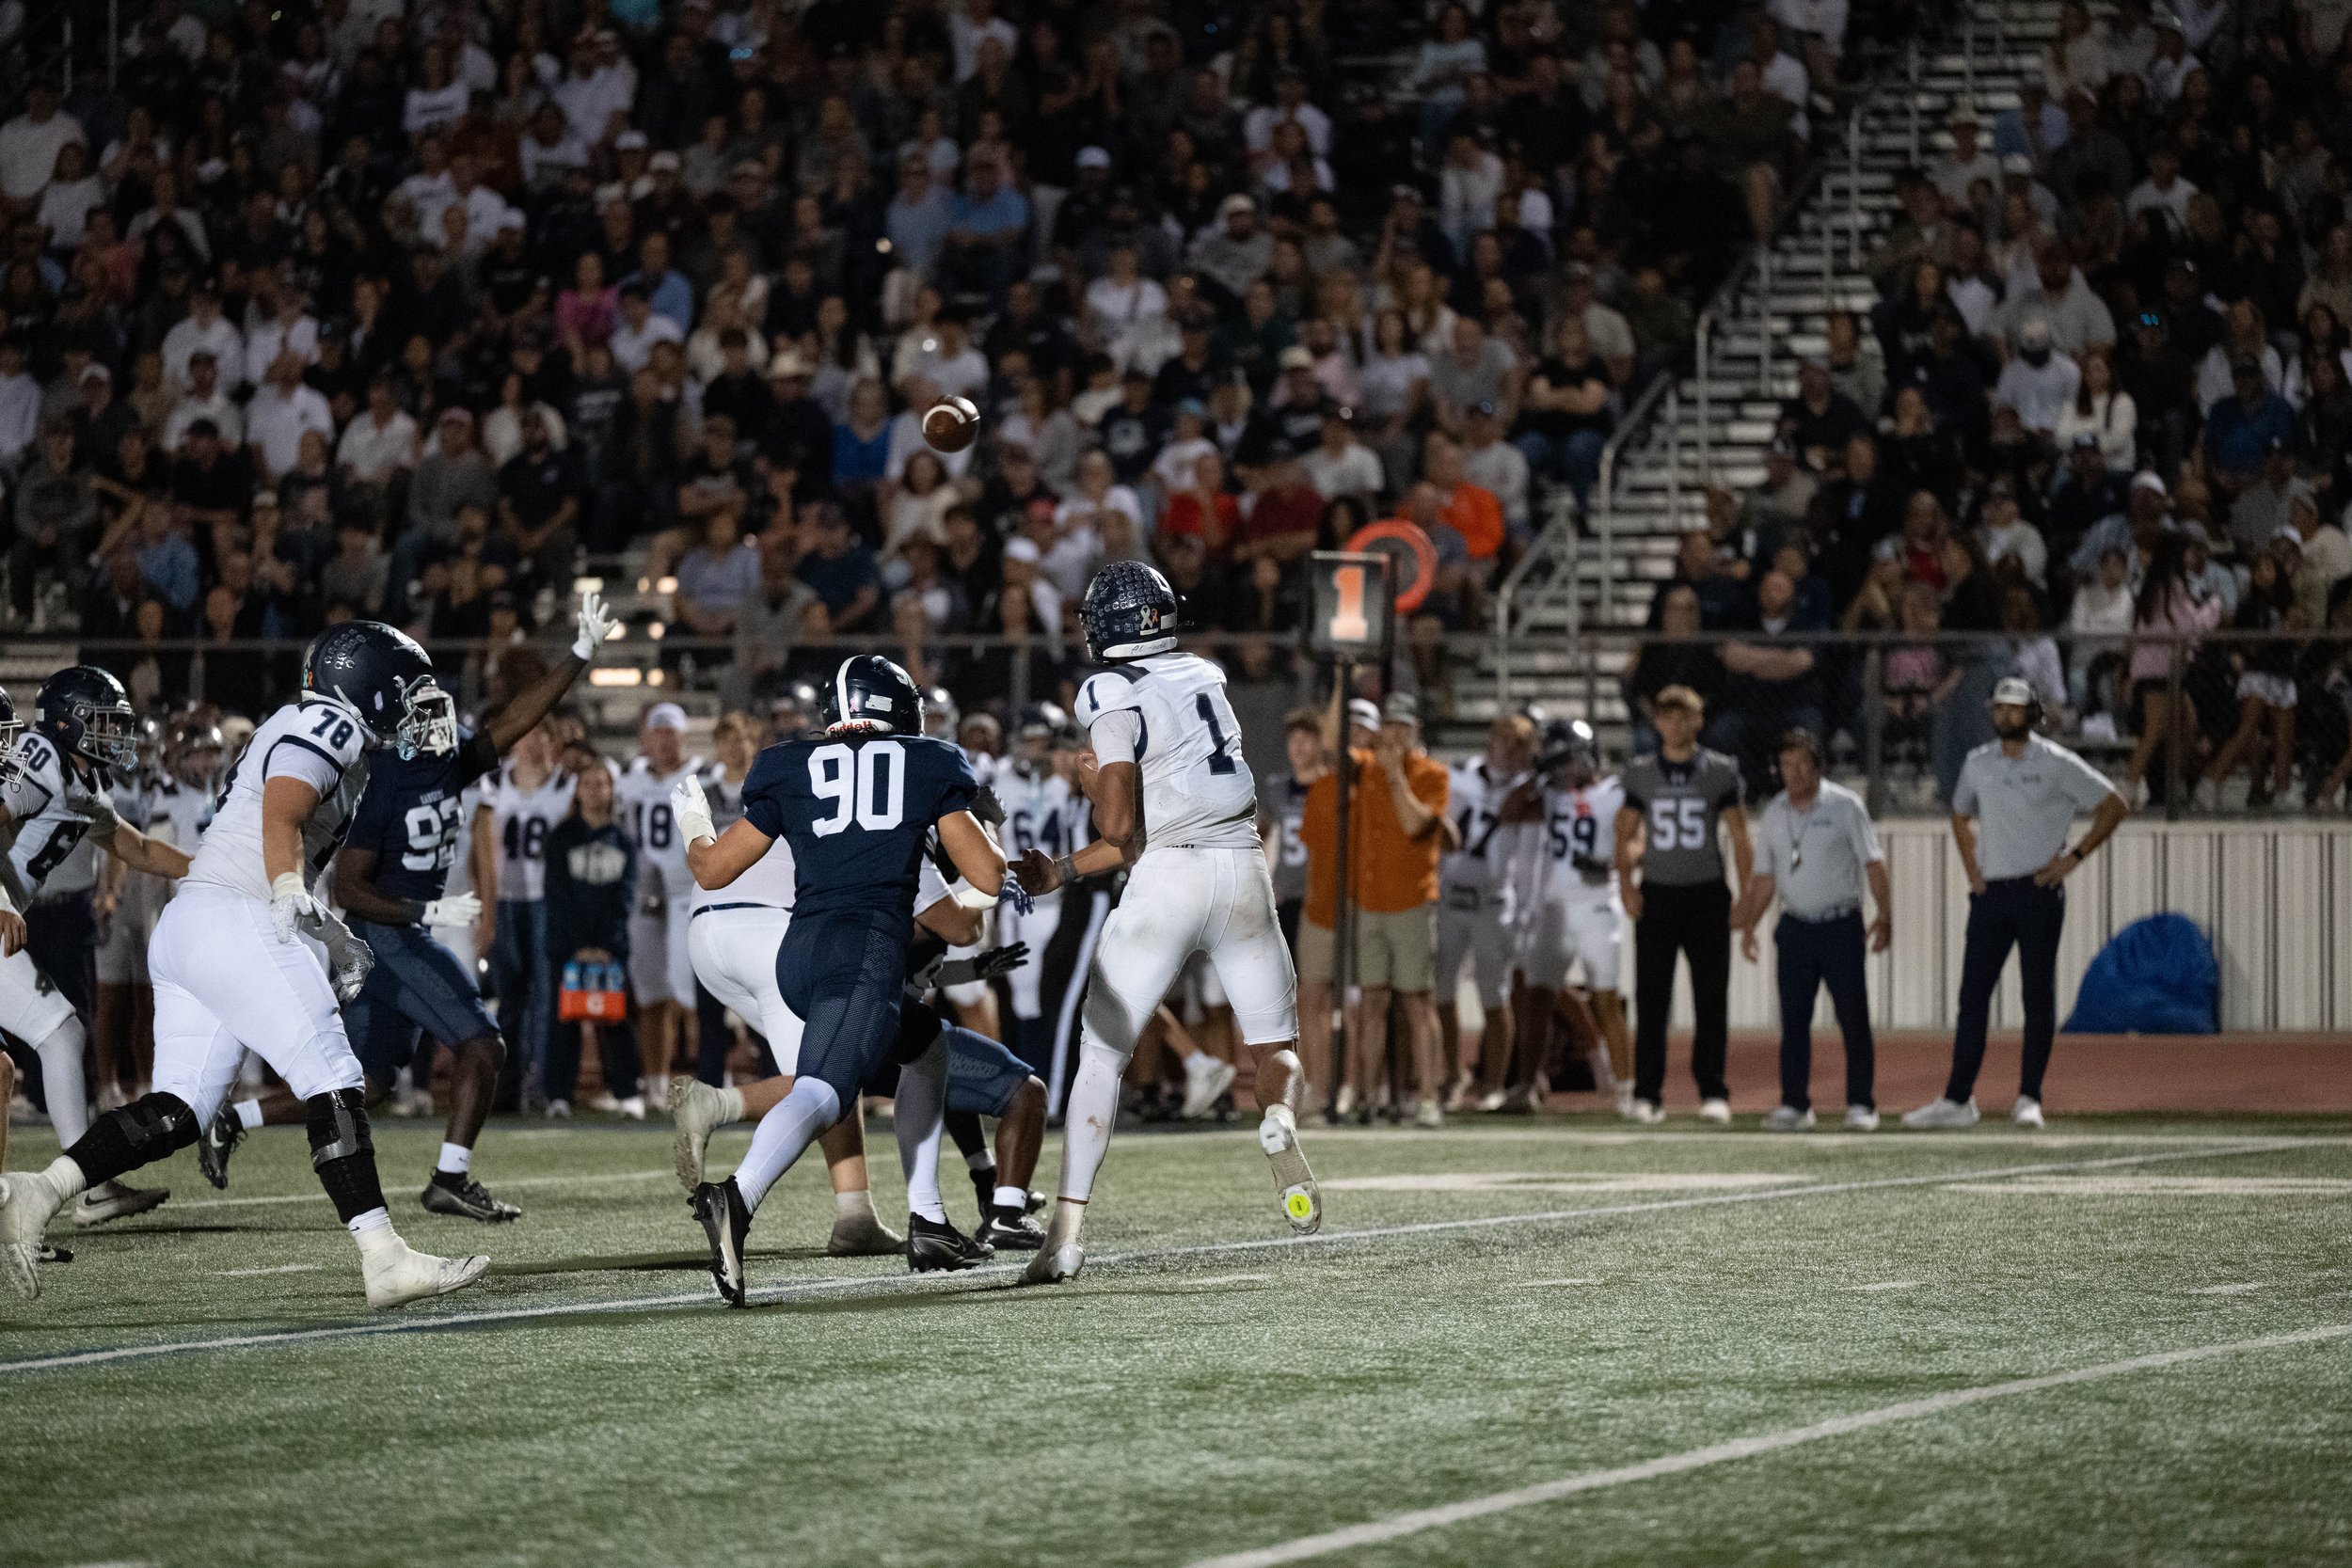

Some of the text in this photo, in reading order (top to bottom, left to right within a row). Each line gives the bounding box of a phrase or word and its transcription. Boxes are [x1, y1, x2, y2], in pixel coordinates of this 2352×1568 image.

[1329, 566, 1368, 641] 1
[1086, 680, 1100, 712] 1
[310, 708, 354, 751] 78
[1196, 692, 1236, 775] 1
[21, 736, 52, 772] 60
[807, 740, 906, 839] 90
[634, 803, 672, 848] 18
[1013, 809, 1060, 855] 64
[1549, 811, 1597, 860] 59
[1652, 799, 1707, 850] 55
